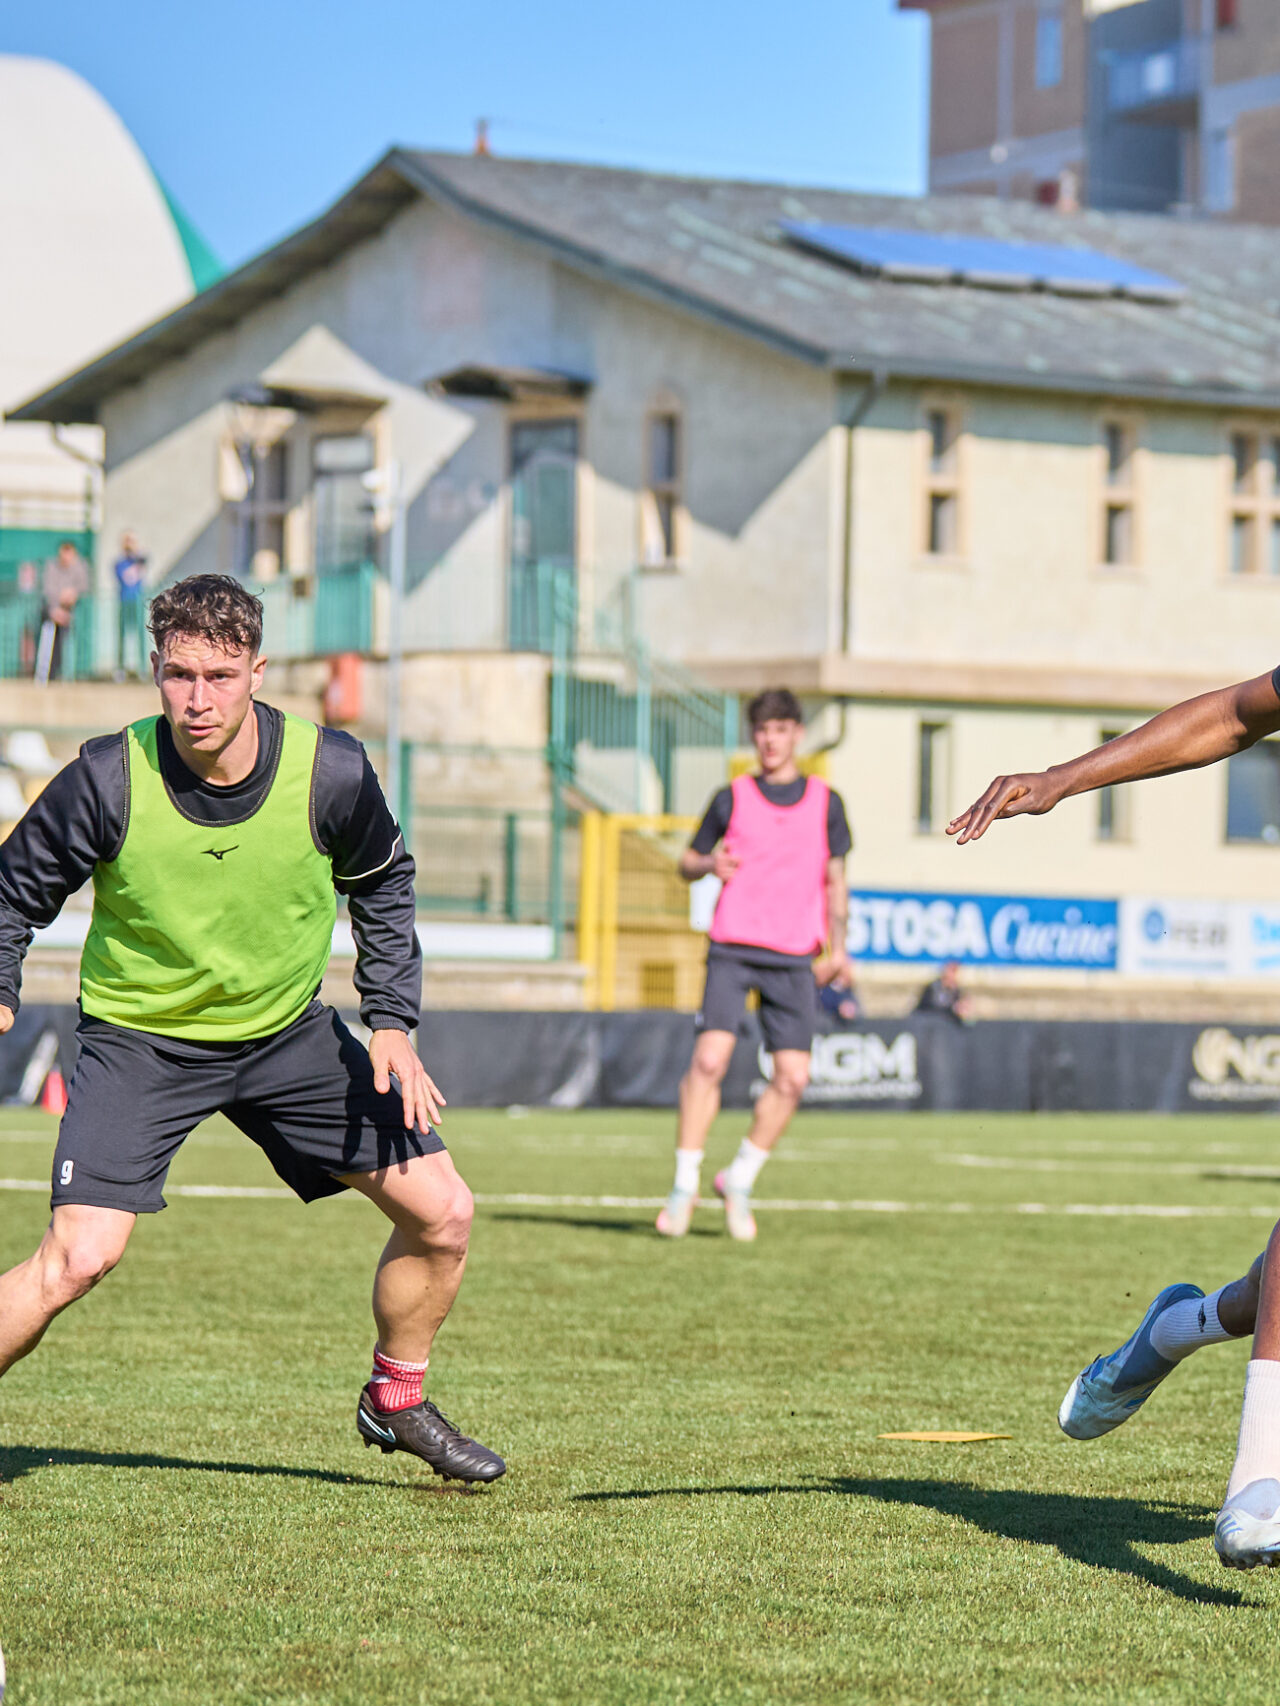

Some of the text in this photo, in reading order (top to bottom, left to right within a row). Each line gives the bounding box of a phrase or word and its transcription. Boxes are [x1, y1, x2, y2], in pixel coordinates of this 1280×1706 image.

[847, 898, 989, 957] STOSA
[990, 903, 1117, 963] Cucine
[812, 1033, 917, 1083] GM
[60, 1160, 74, 1186] 9
